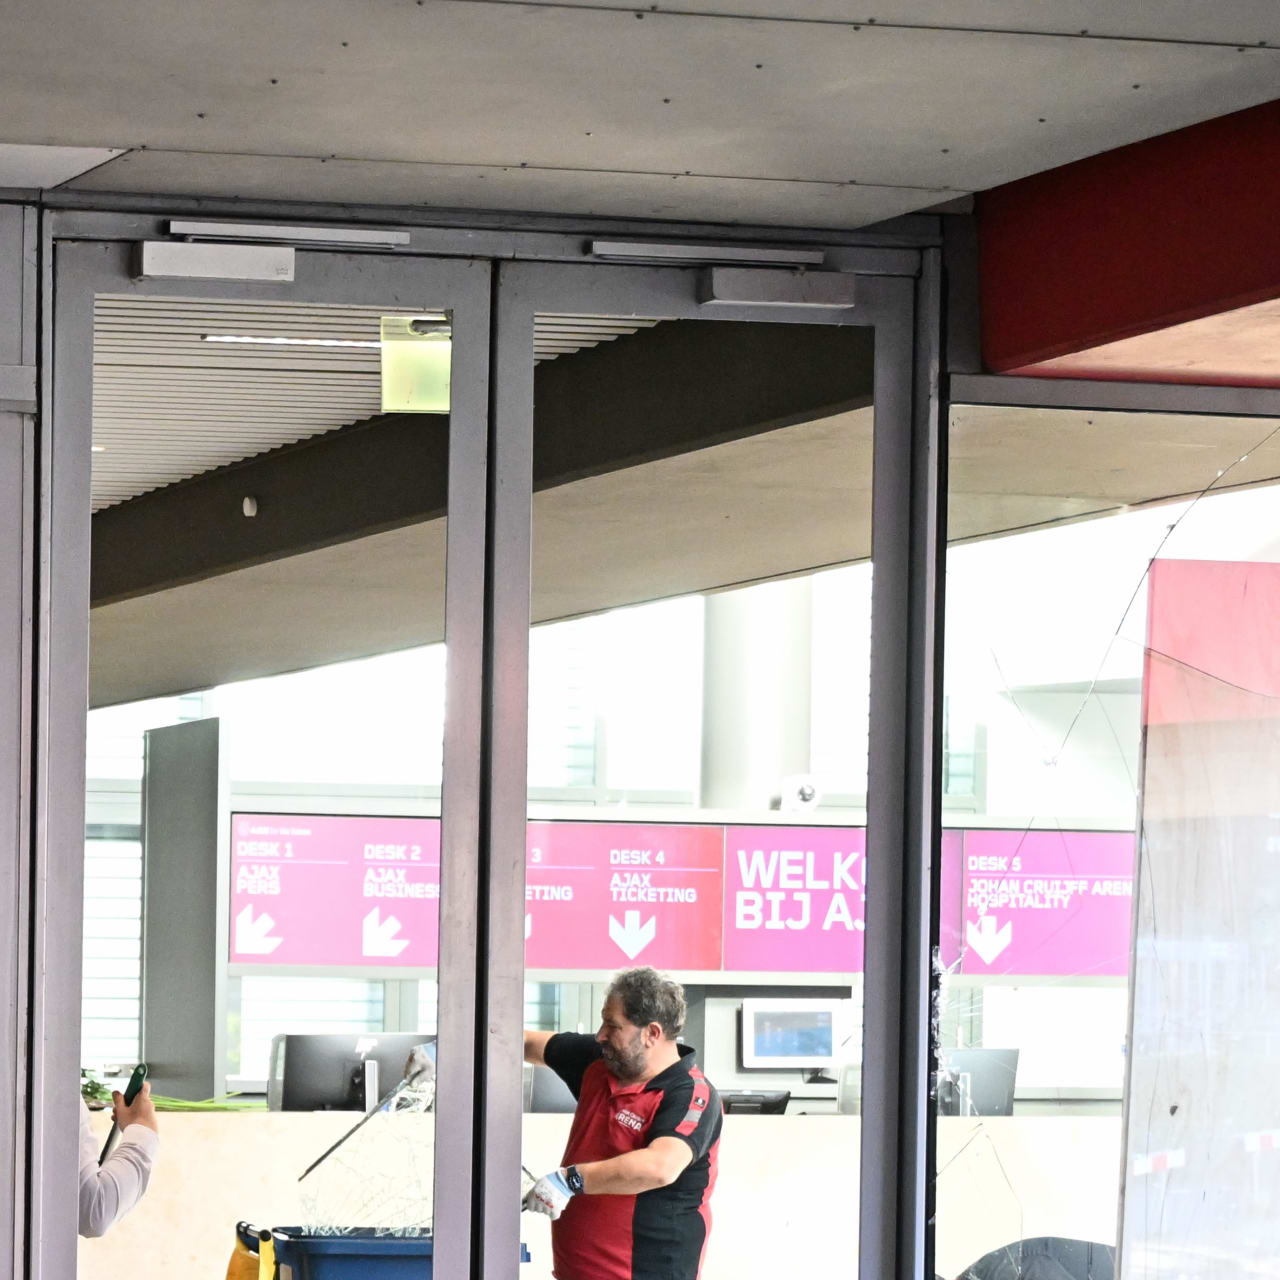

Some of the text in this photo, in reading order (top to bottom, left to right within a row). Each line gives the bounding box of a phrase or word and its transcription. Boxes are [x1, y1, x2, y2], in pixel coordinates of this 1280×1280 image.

[237, 841, 295, 858] DESK 1
[363, 843, 422, 861] DESK 2
[531, 848, 542, 863] 3
[609, 849, 666, 865] DESK 4
[736, 849, 866, 890] WELK
[968, 856, 1022, 872] DESK 5
[238, 865, 281, 881] AJAX
[364, 867, 407, 884] AJAX
[610, 873, 652, 888] AJAX
[236, 879, 281, 896] PERS
[363, 882, 440, 899] BUSINES
[609, 887, 698, 903] TICKETING
[968, 879, 1021, 895] JOHAN
[1024, 880, 1088, 895] CRUIJFF
[967, 893, 1071, 908] HOSPITALITY
[735, 890, 811, 931] BIJ
